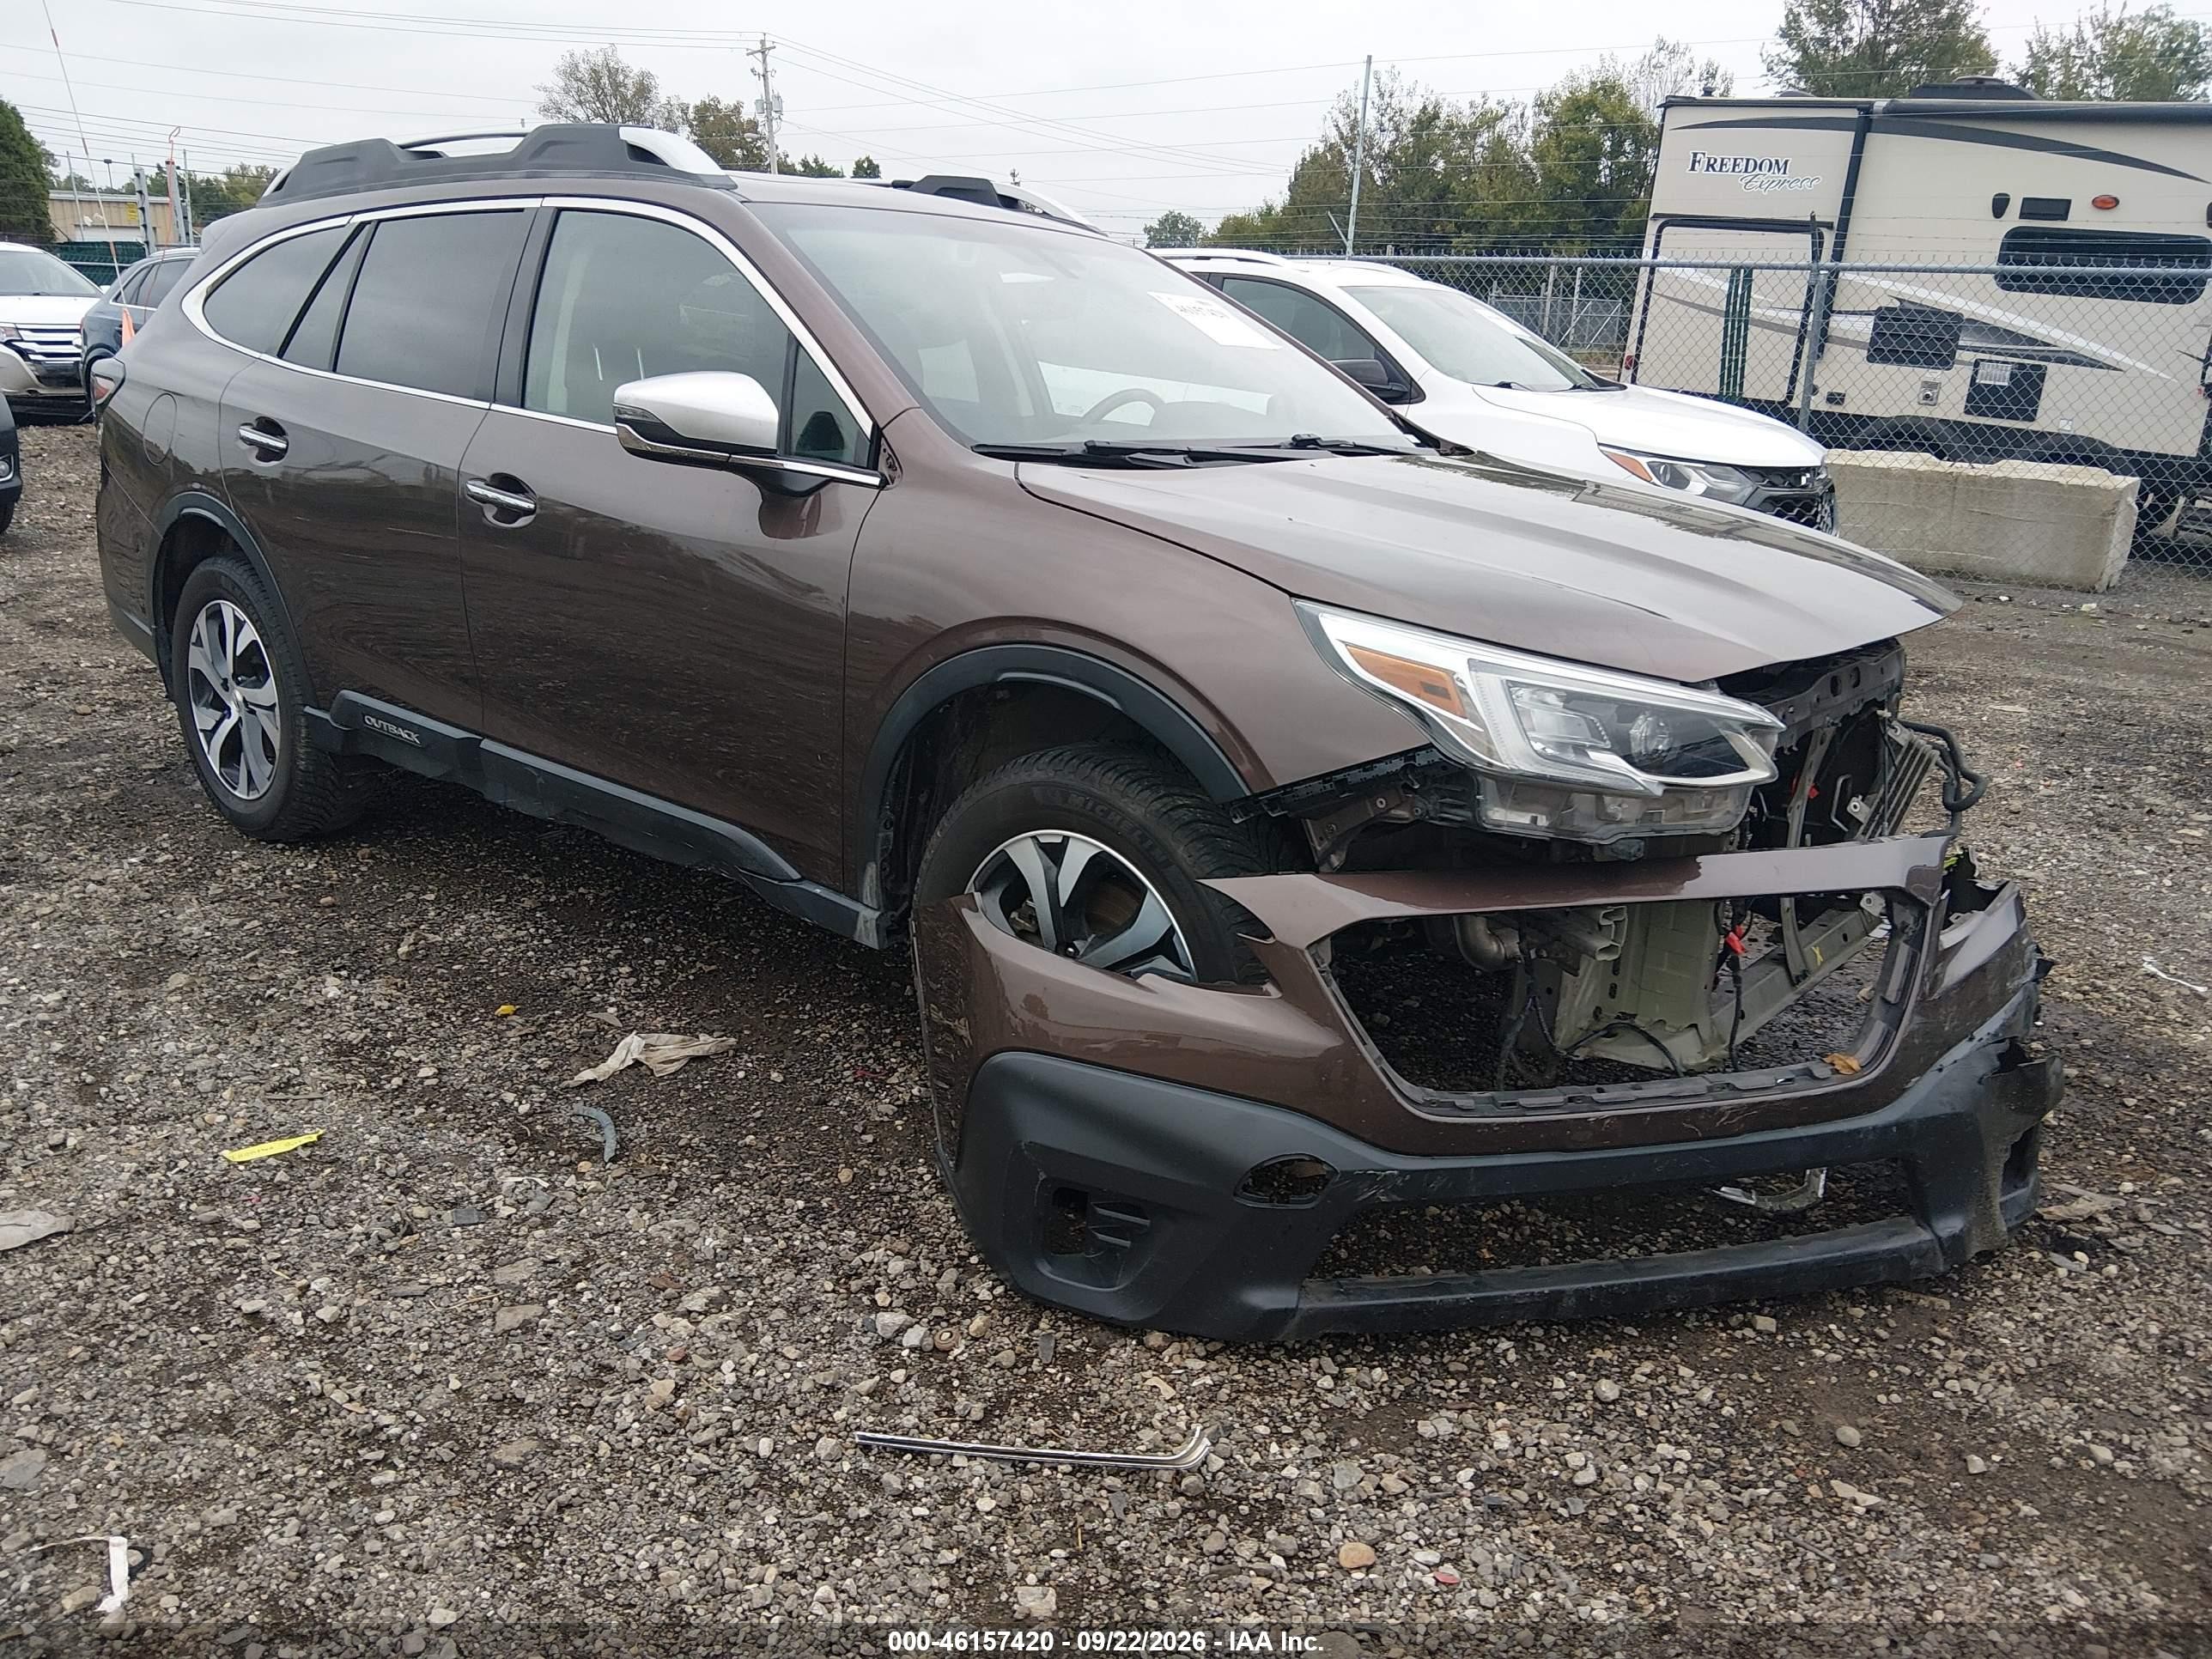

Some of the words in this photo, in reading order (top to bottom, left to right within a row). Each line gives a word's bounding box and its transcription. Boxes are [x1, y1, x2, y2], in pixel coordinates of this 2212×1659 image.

[1688, 151, 1790, 175] FREEDOM
[1740, 173, 1821, 192] Express
[364, 714, 422, 745] OUTBACK
